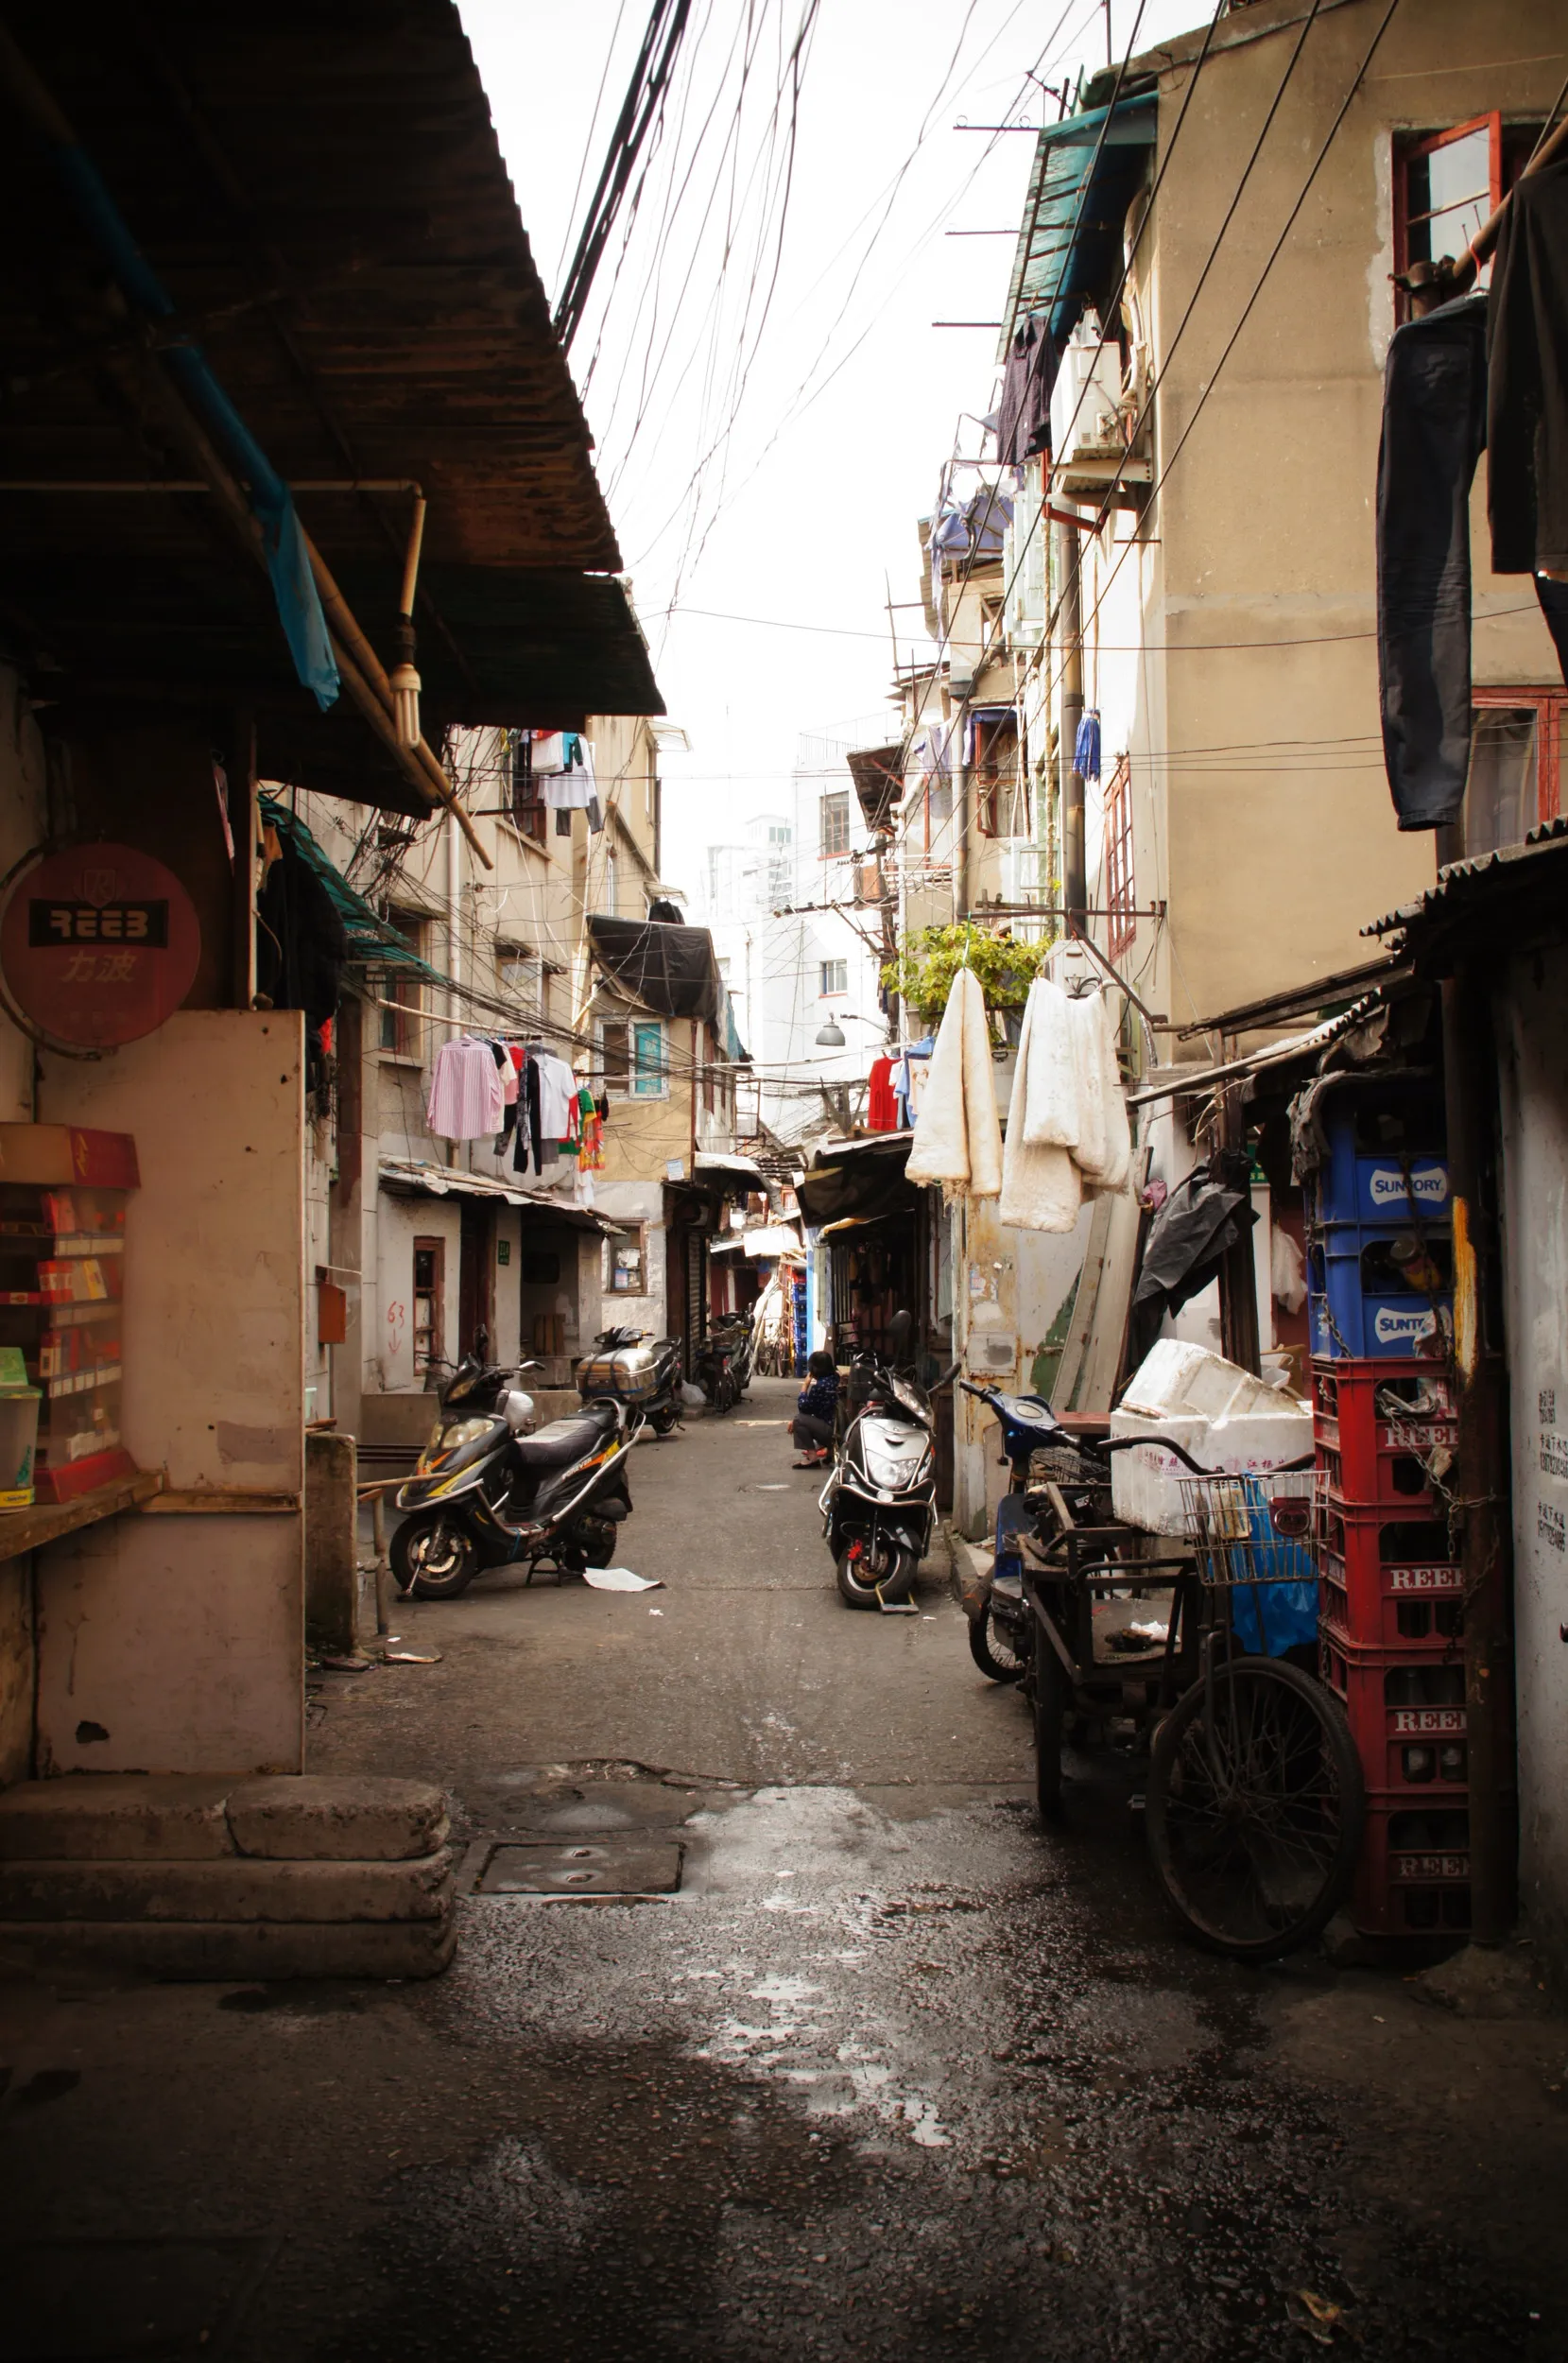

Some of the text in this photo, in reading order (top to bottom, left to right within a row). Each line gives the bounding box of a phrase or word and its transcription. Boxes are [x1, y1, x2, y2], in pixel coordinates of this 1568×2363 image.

[50, 909, 149, 938] REEB
[59, 949, 138, 983] 力波
[1375, 1179, 1442, 1193] SUNORY
[1380, 1317, 1426, 1332] SUNT
